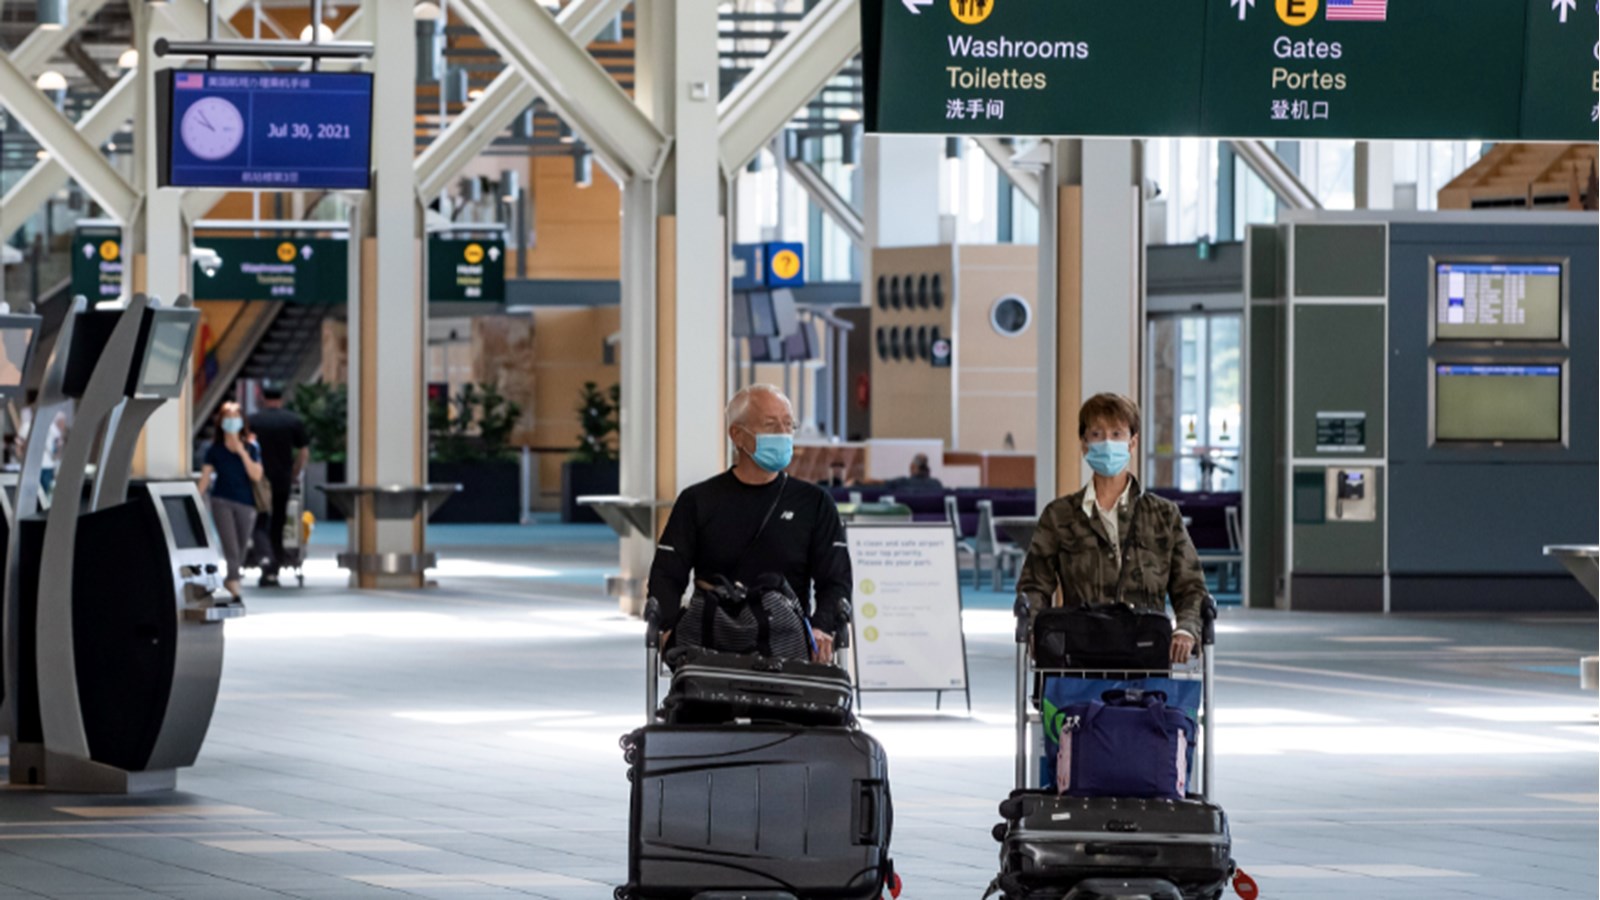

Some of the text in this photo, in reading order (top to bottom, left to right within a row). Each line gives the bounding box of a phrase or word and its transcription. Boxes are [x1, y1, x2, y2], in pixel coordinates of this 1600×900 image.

[947, 35, 1089, 59] Washrooms
[1273, 36, 1343, 59] Gates
[946, 66, 1047, 90] Toilettes
[1272, 67, 1347, 90] Portes
[945, 98, 1004, 120] 洗手间
[1270, 99, 1329, 120] 登机口
[267, 123, 350, 140] Jul 30, 2021
